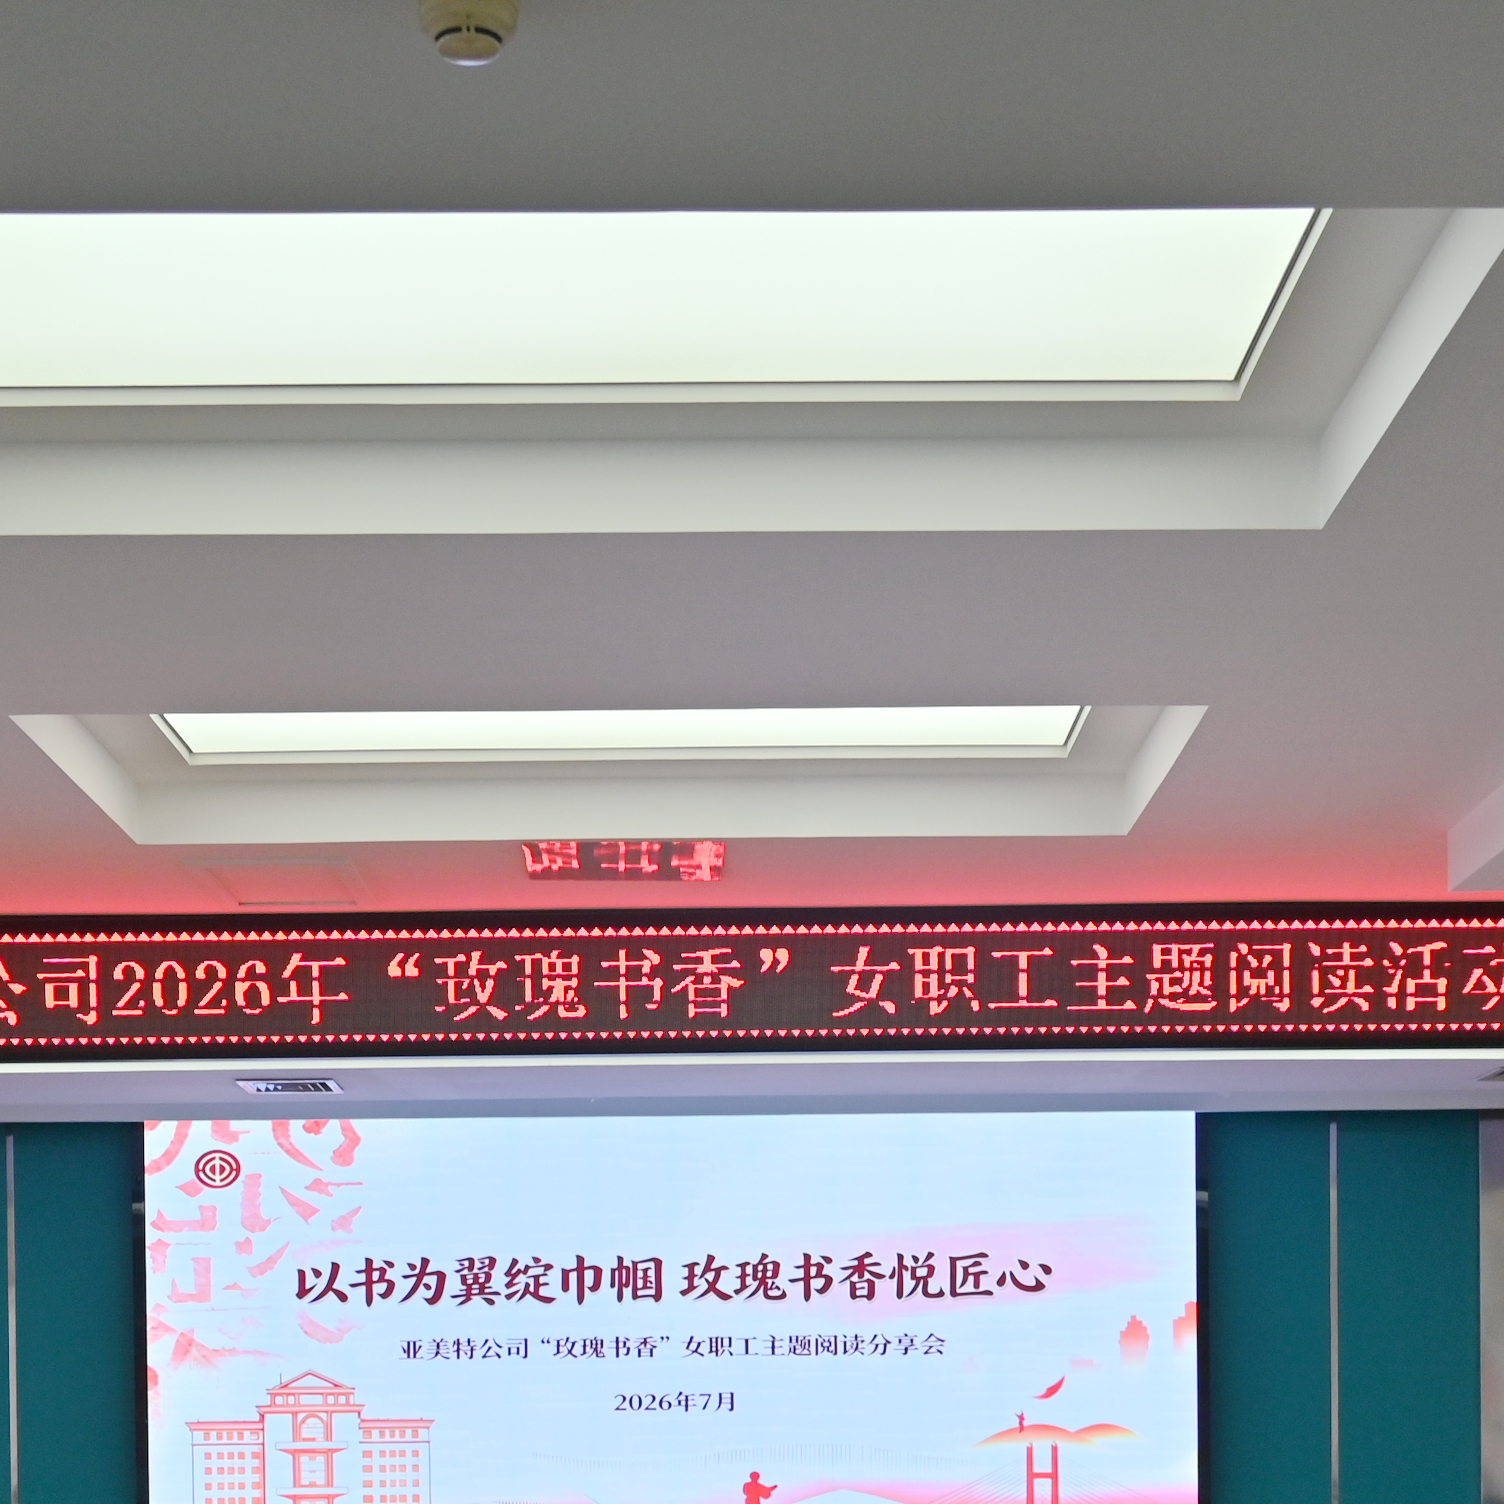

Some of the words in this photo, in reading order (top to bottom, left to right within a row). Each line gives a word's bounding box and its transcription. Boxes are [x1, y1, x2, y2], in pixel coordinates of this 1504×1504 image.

[296, 1255, 663, 1306] 以书为翼绽巾帼
[680, 1252, 1053, 1303] 玫瑰书香悦匠心
[614, 1390, 736, 1413] 2026年7月
